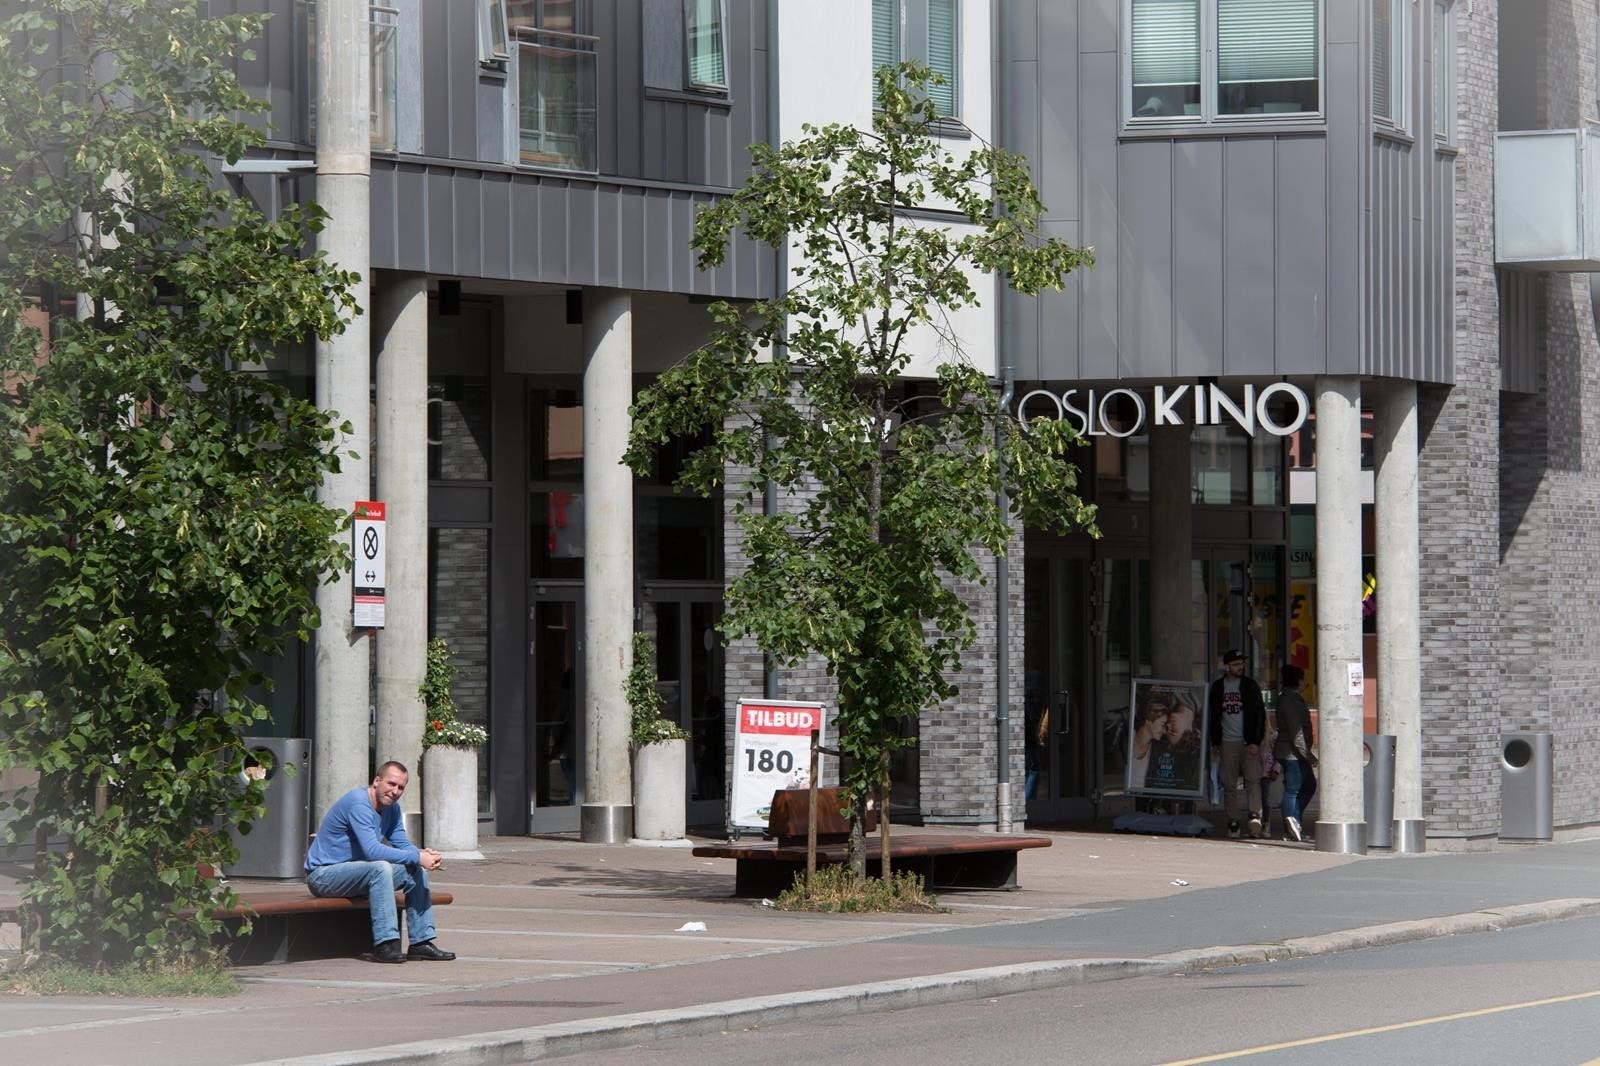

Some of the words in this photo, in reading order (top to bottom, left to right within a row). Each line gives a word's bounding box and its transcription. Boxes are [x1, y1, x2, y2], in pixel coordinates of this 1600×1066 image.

[1018, 388, 1146, 438] OSLO
[1154, 382, 1310, 437] KINO
[747, 710, 813, 728] TILBUD
